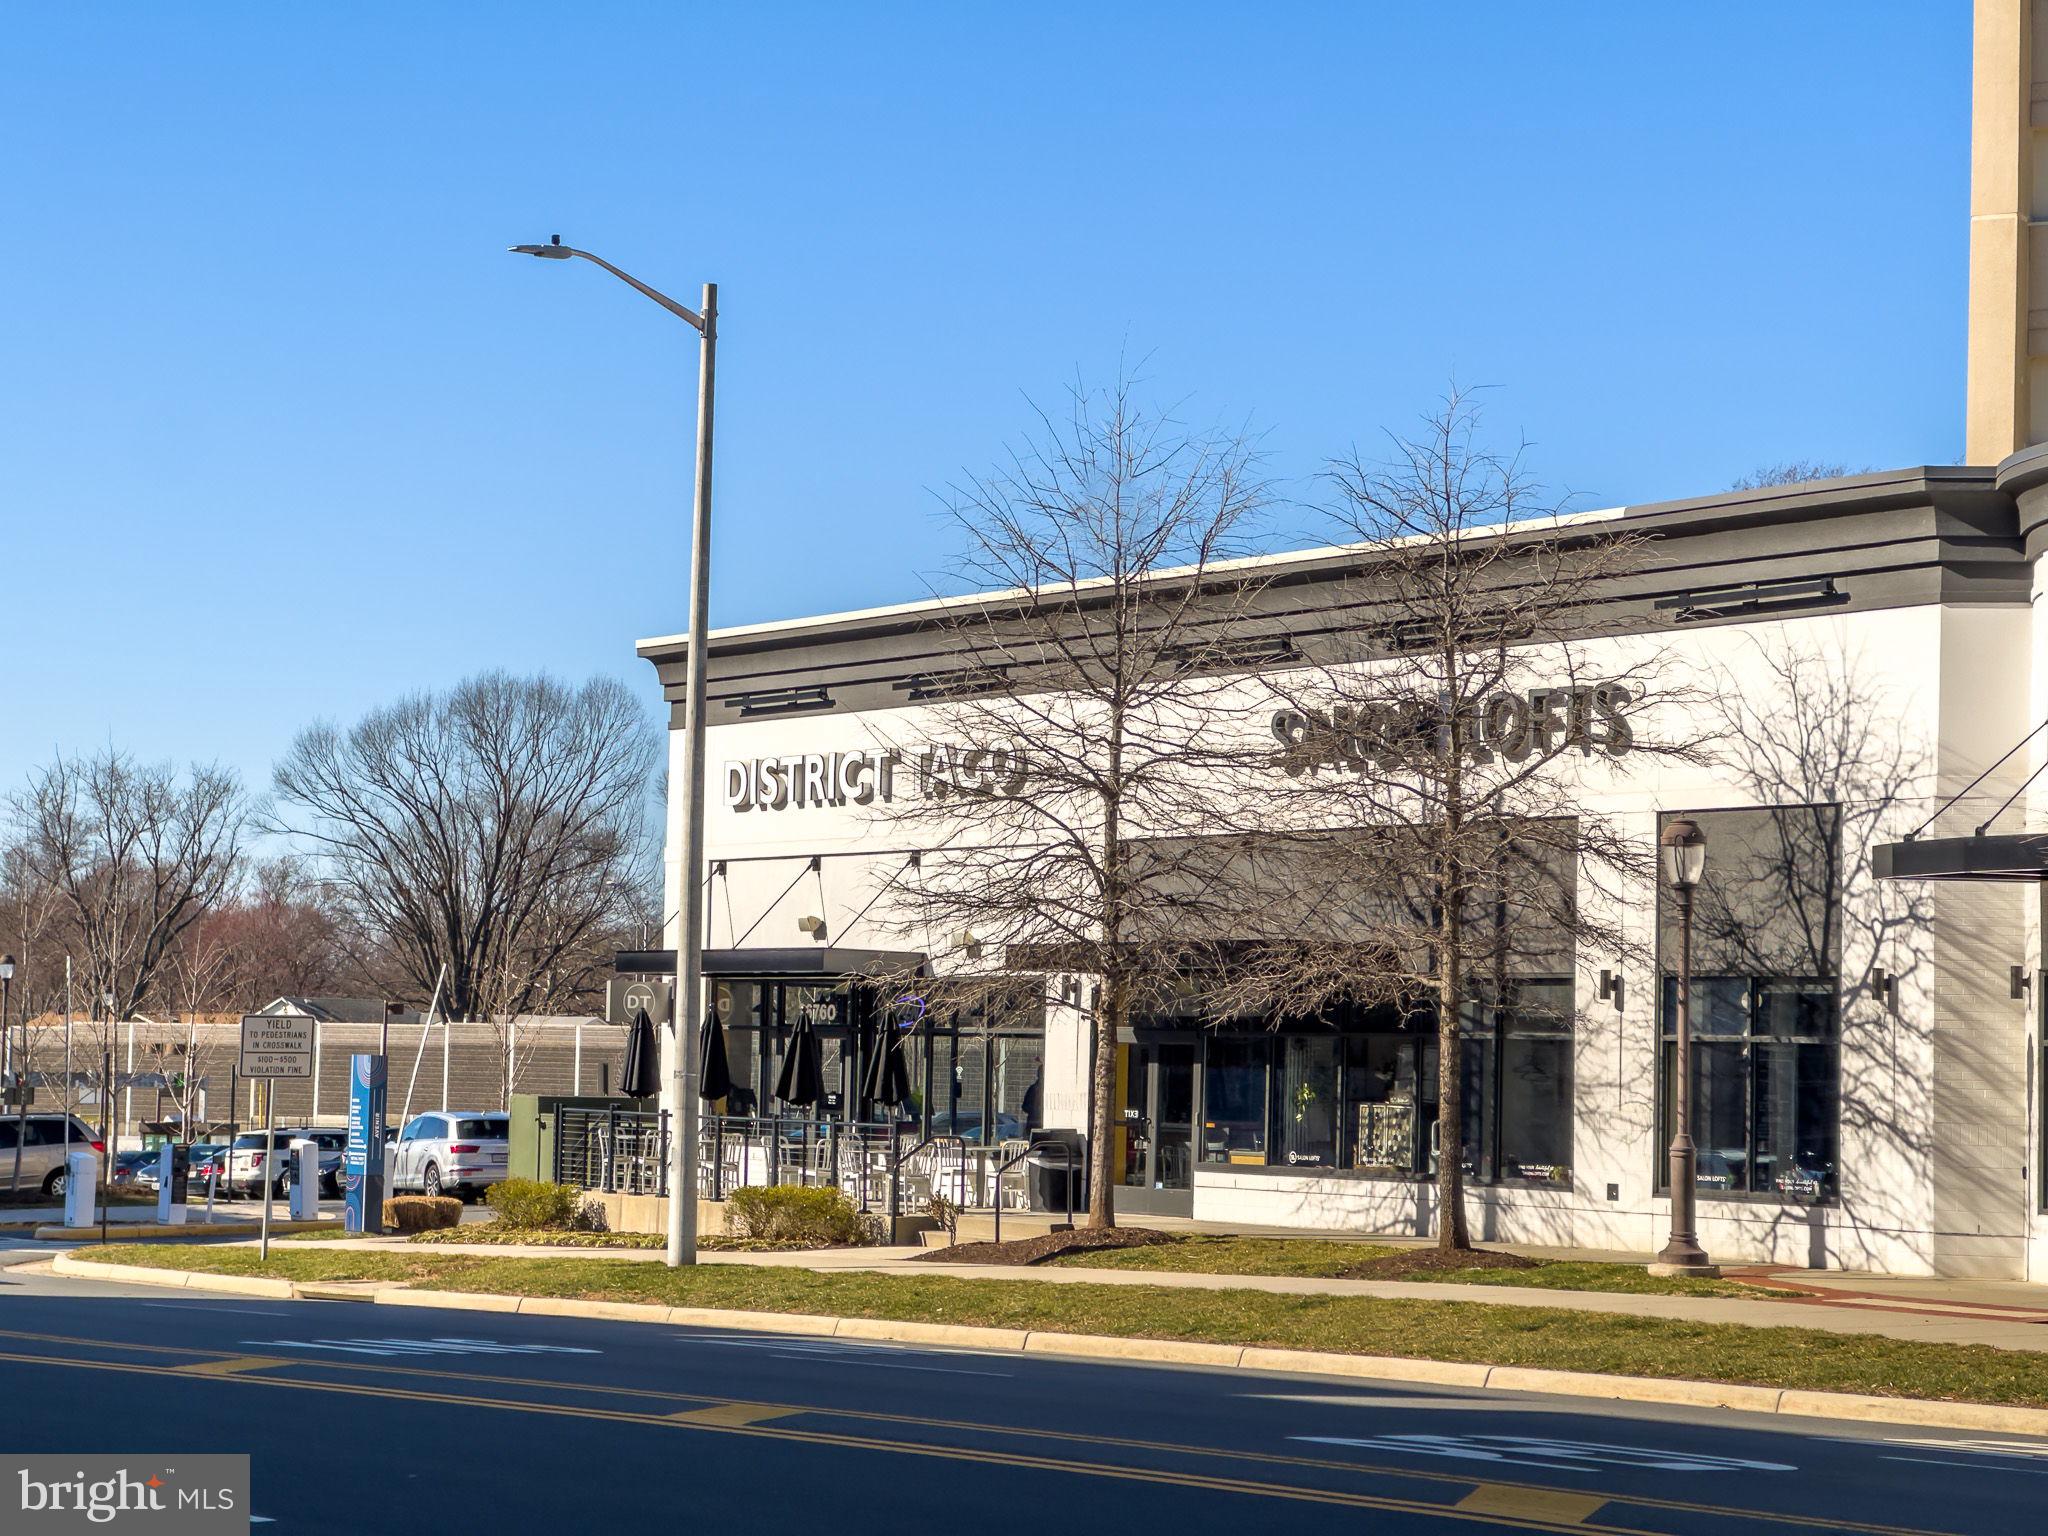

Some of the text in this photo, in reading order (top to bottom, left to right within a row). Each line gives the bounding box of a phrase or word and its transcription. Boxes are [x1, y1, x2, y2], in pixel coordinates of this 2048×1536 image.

[1271, 698, 1452, 774] SALO
[723, 737, 1025, 809] DISTRICT TACO
[627, 994, 652, 1009] DT
[266, 1019, 292, 1029] YIELD
[249, 1030, 307, 1039] TO PEDESTRIANS
[252, 1041, 303, 1049] IN CROSSWALK
[249, 1065, 303, 1074] VIOLATION FINE
